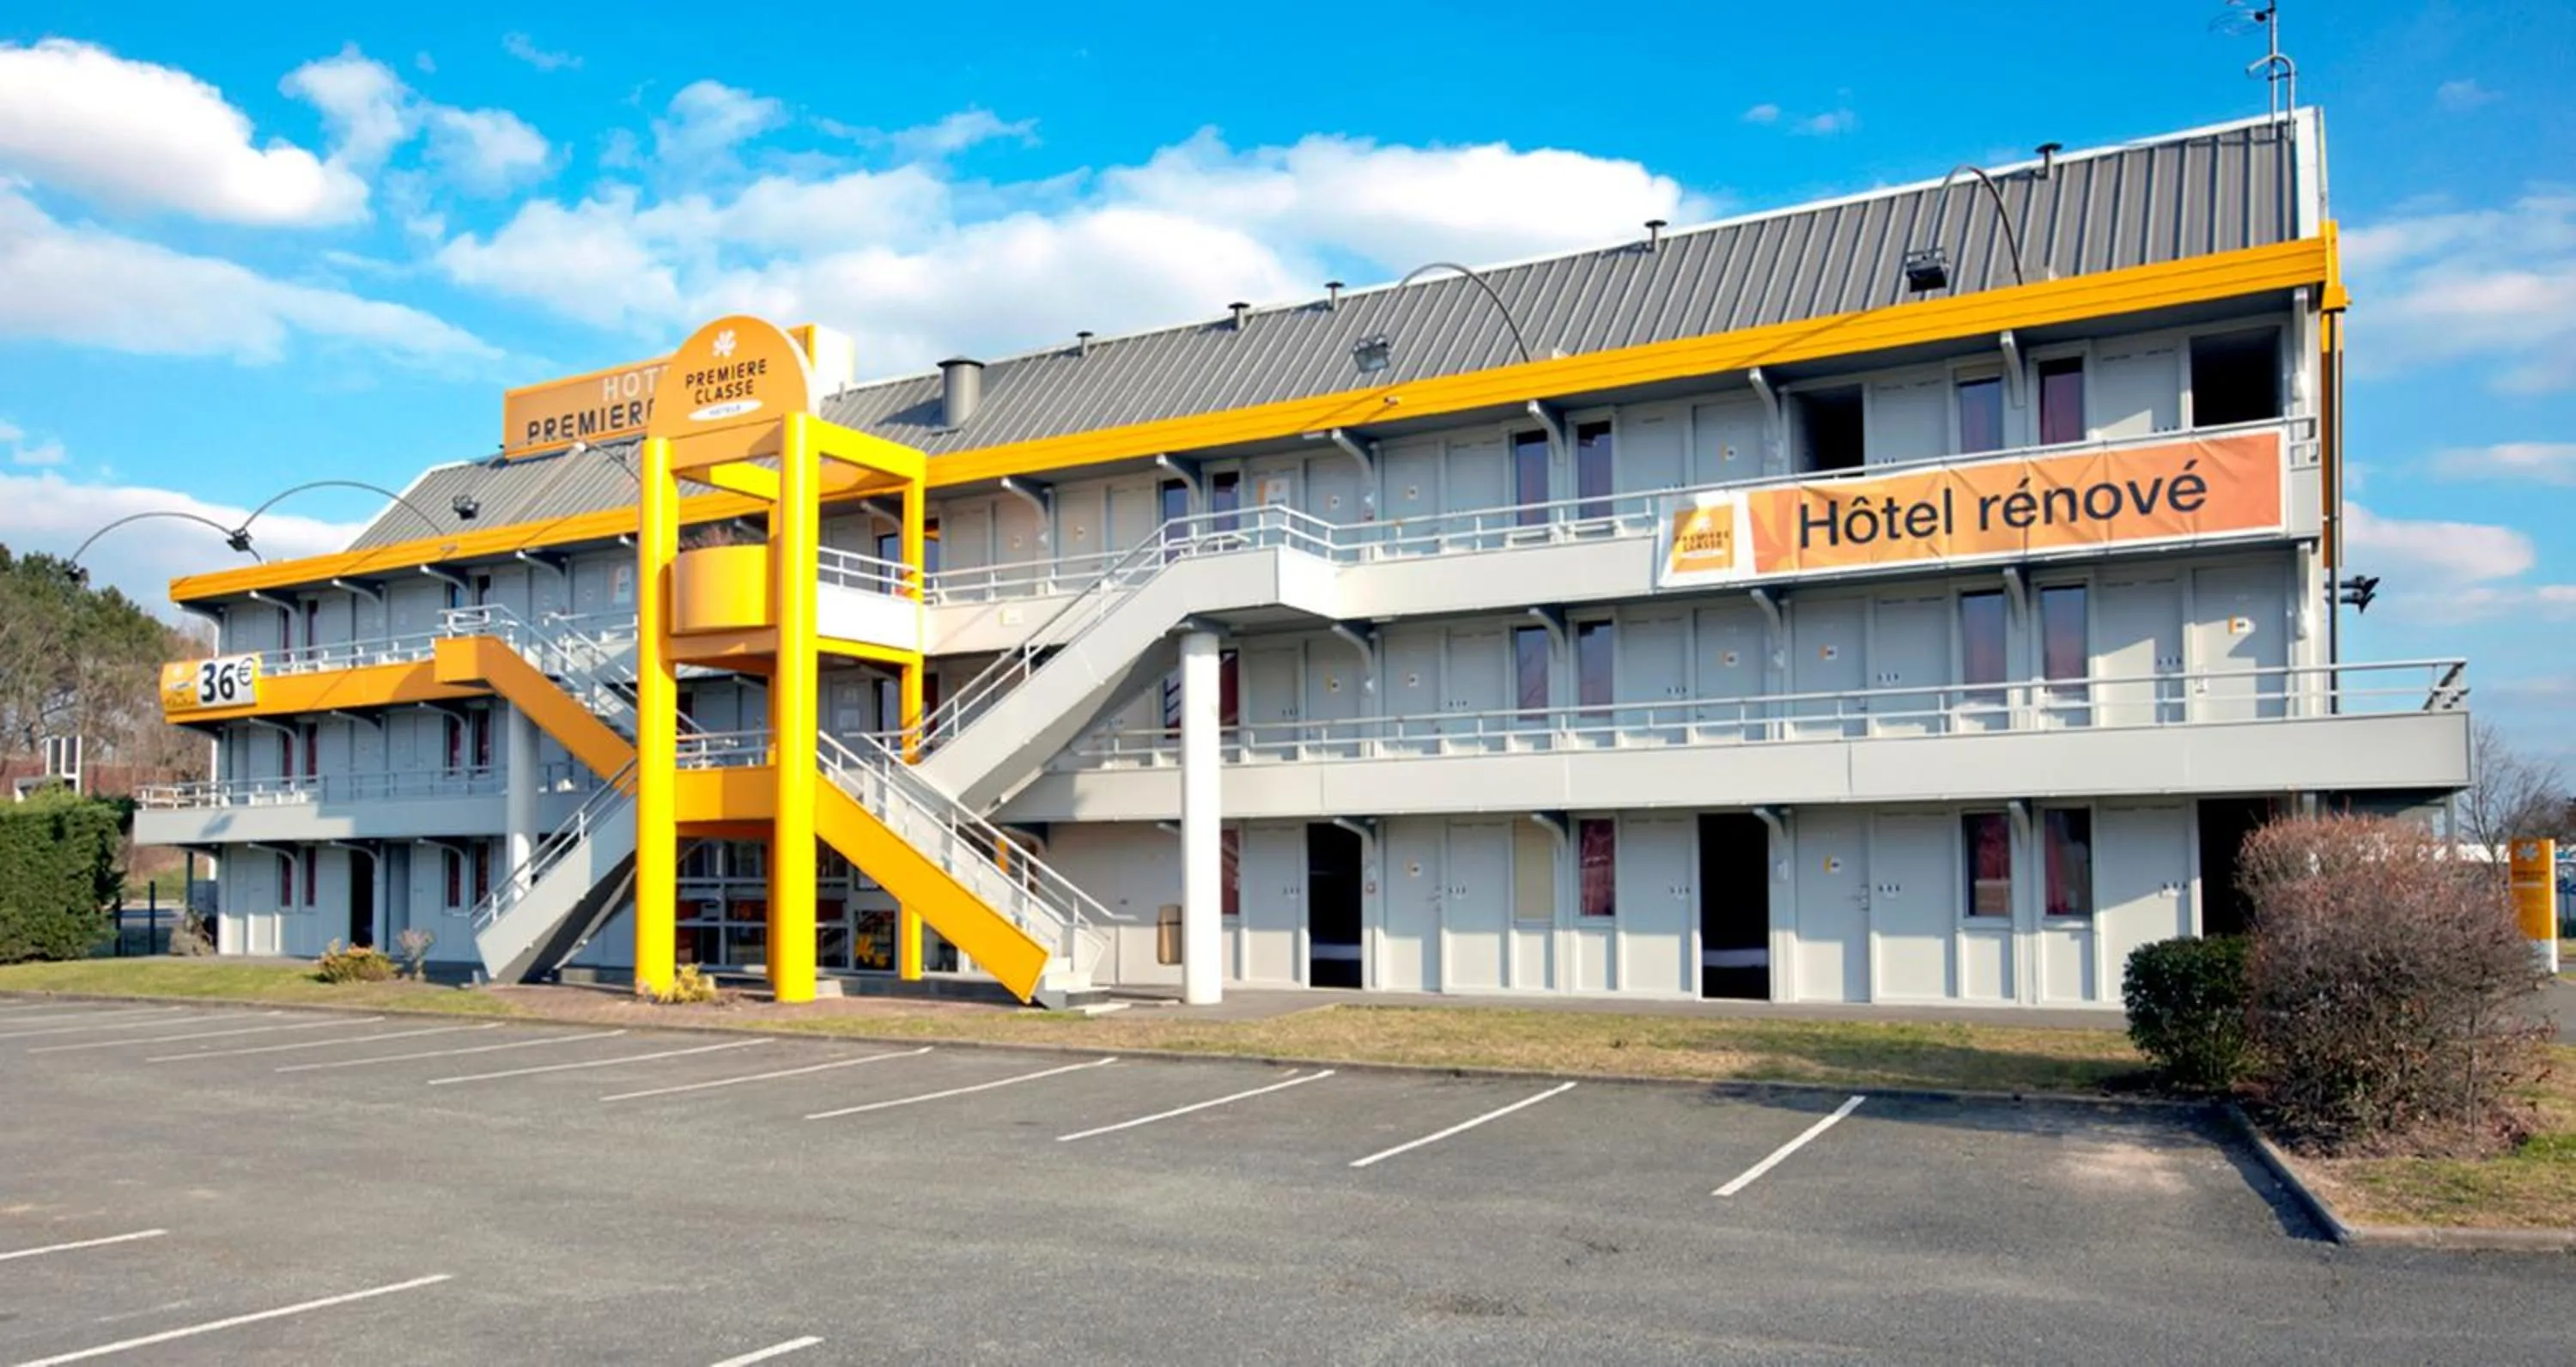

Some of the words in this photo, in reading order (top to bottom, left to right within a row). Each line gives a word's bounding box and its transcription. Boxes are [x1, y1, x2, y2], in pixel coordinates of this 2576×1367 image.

[603, 364, 670, 402] HOT
[684, 358, 767, 390] PREMIERE
[694, 378, 754, 404] CLASSE
[1801, 487, 1953, 549] Hôtel
[1979, 459, 2208, 531] rénové
[200, 657, 255, 703] 36€
